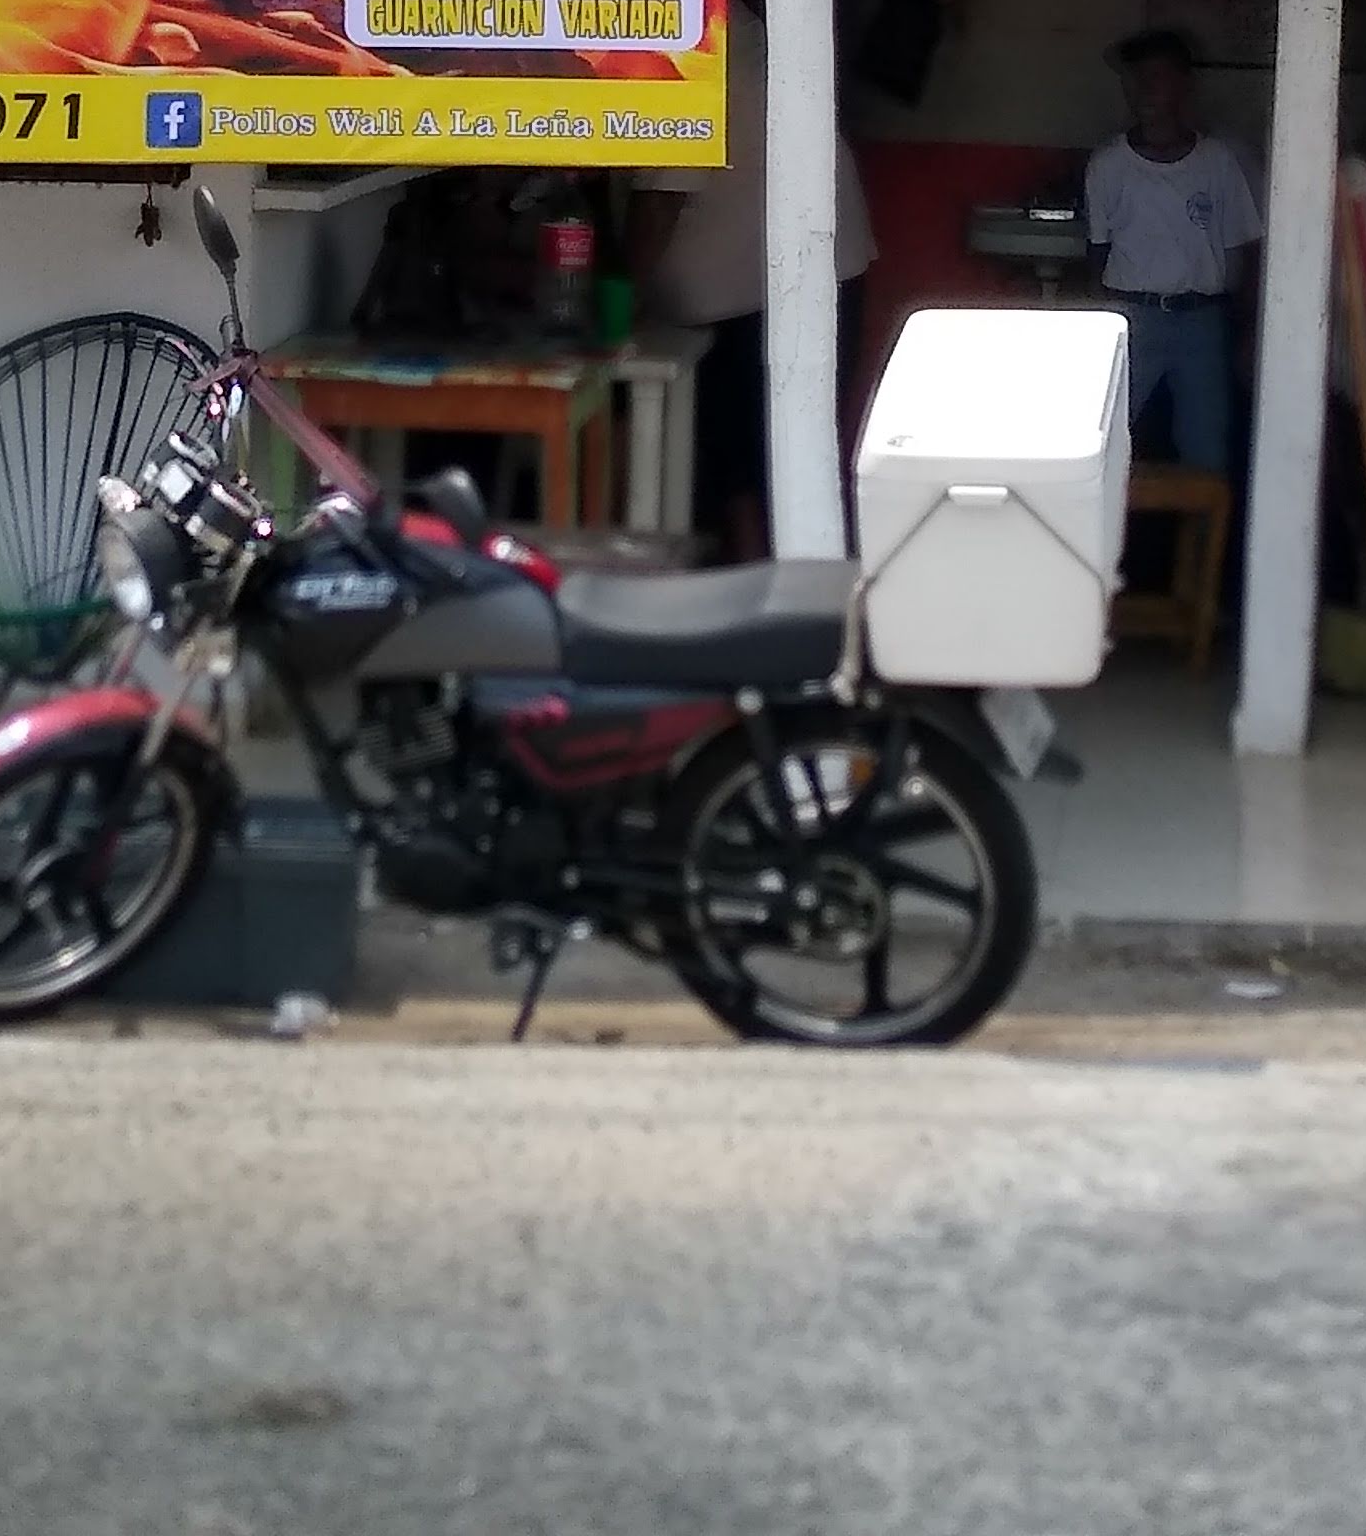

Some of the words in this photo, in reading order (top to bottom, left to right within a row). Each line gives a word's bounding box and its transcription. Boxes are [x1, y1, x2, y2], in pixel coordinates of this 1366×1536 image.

[210, 107, 317, 137] Pollos
[327, 107, 403, 137] Wali
[412, 110, 441, 137] A
[450, 109, 496, 138] La
[505, 107, 594, 139] Leña
[603, 110, 713, 141] Macas
